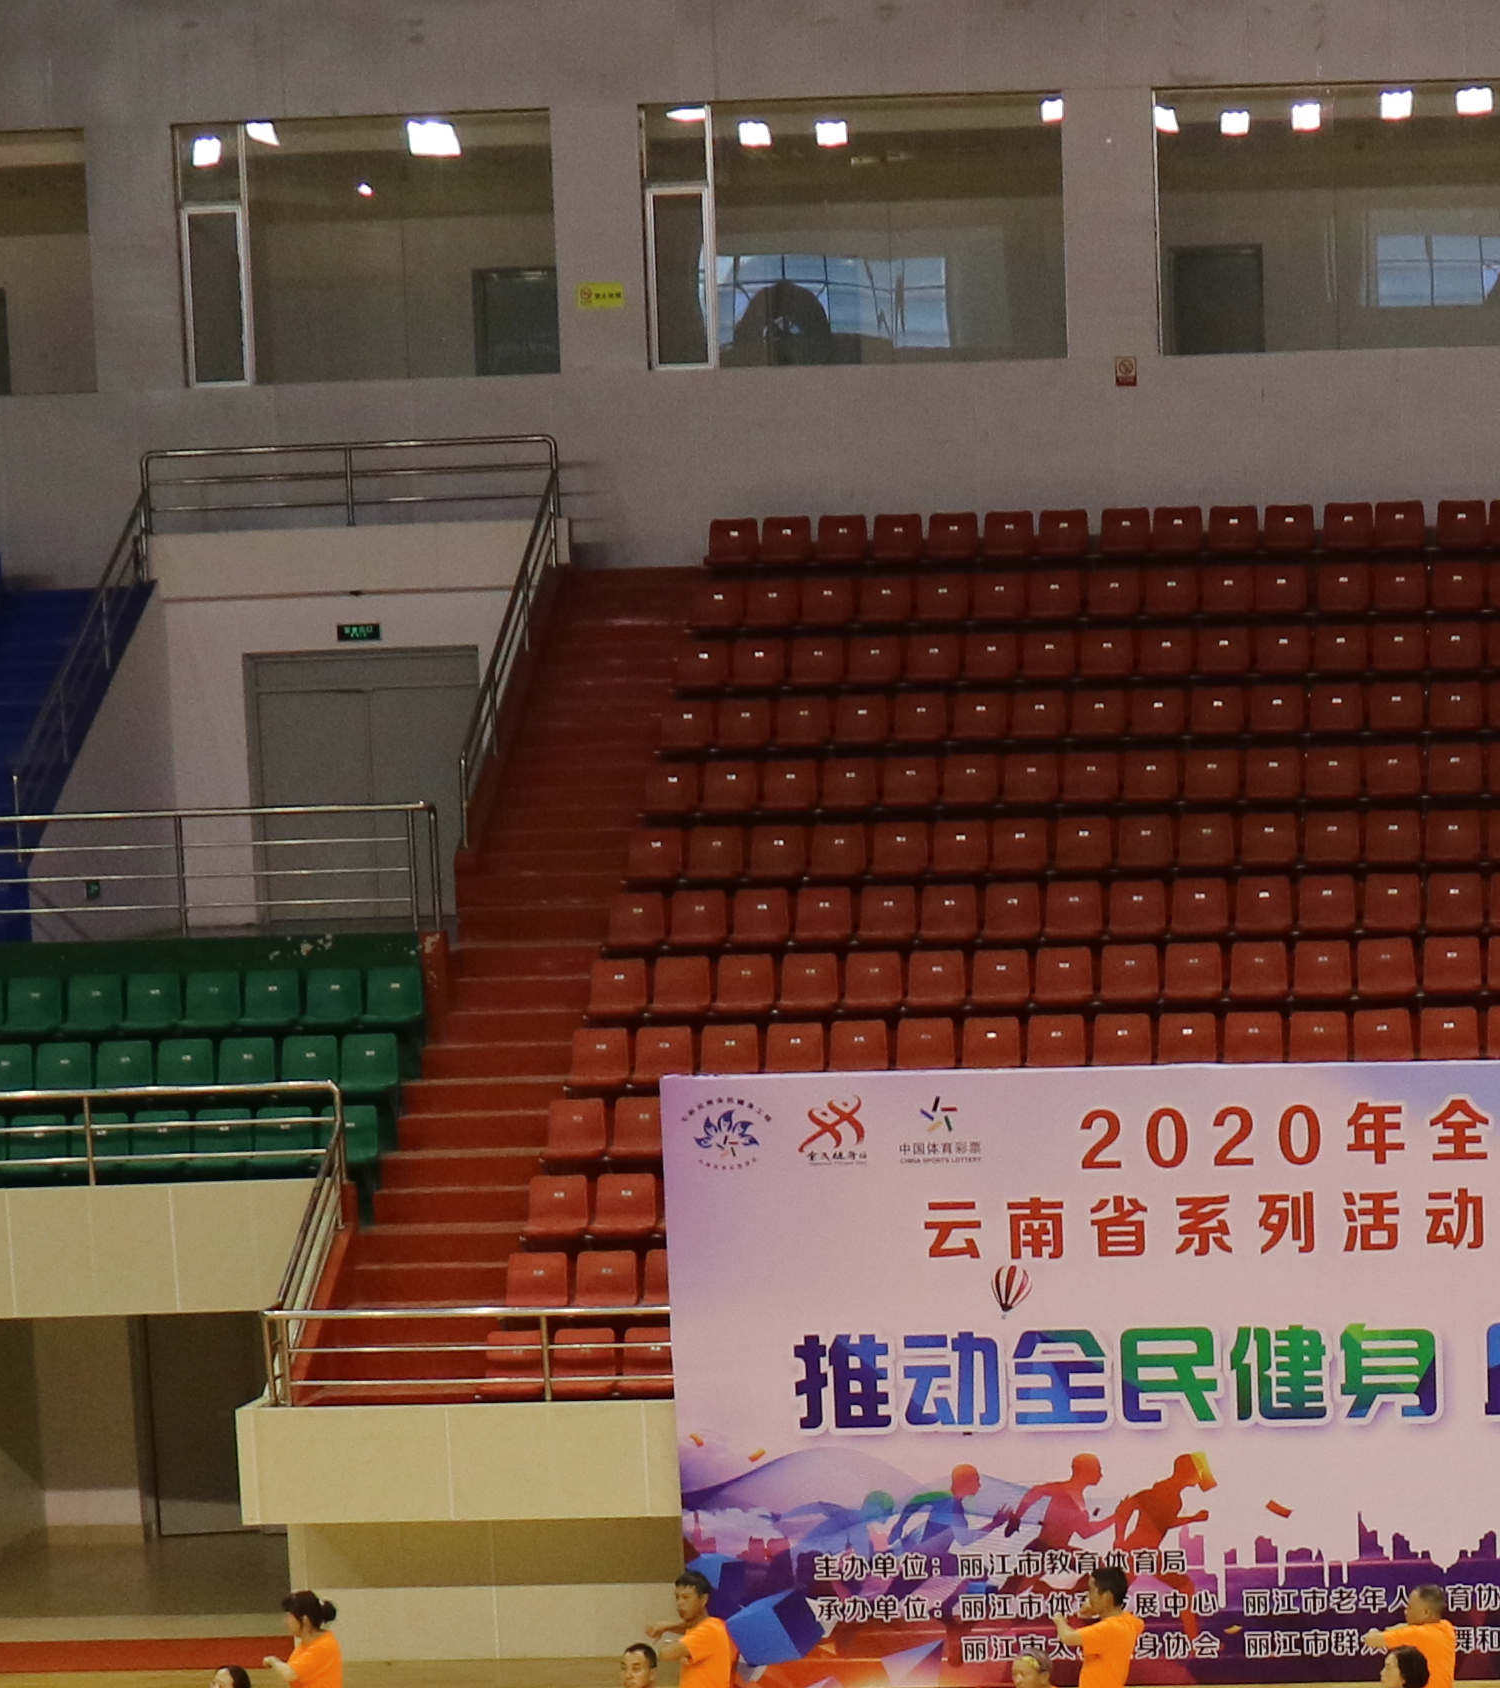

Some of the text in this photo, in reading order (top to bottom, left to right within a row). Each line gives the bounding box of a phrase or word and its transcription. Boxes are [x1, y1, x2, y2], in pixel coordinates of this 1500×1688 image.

[792, 1322, 1440, 1434] 推动全民健身
[961, 1632, 1221, 1661] 丽江市太身协会
